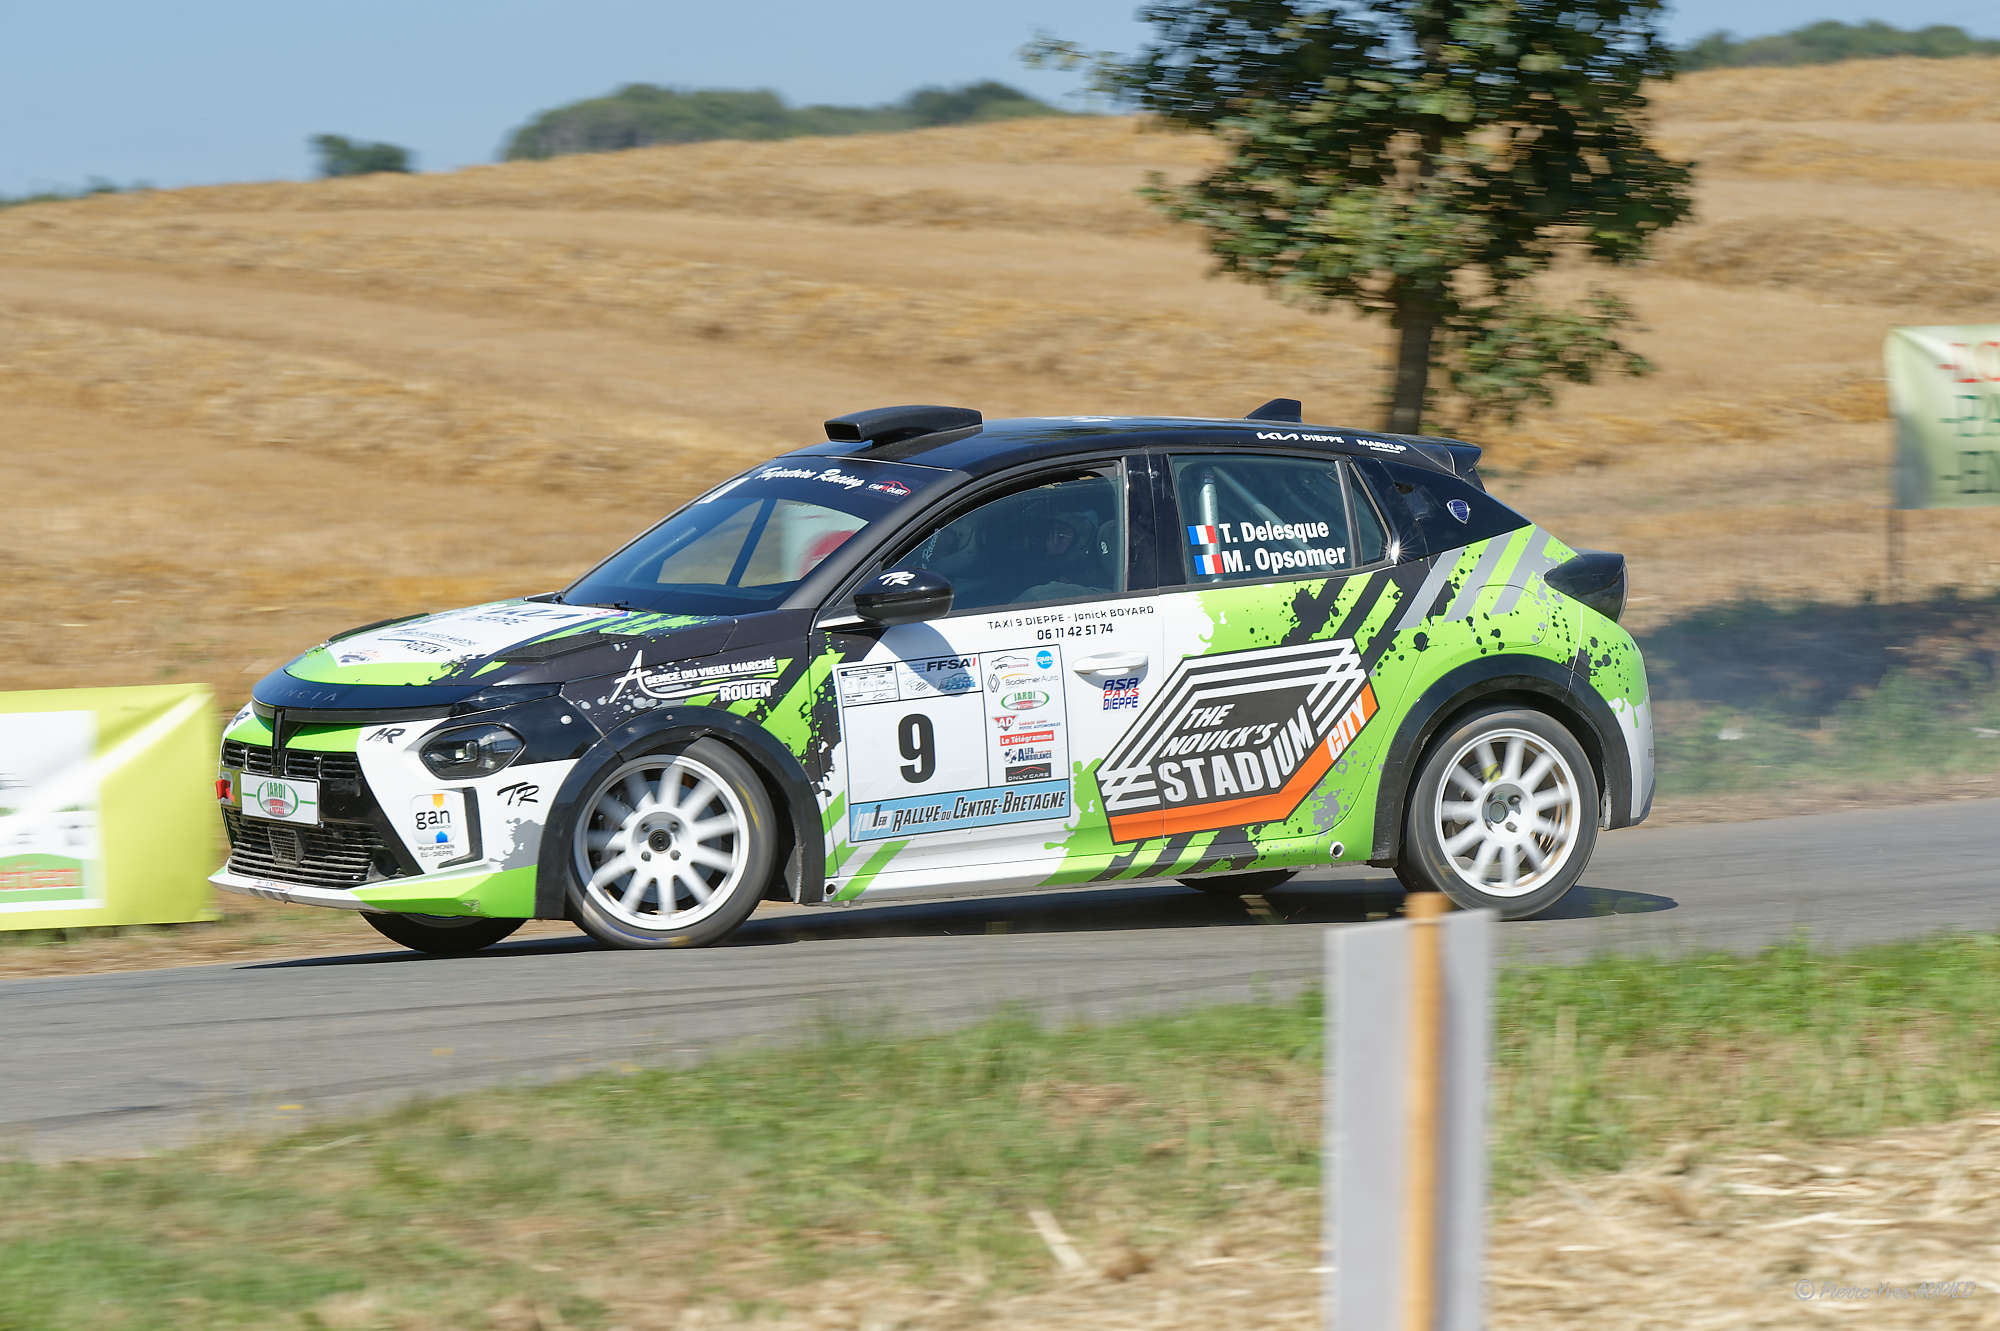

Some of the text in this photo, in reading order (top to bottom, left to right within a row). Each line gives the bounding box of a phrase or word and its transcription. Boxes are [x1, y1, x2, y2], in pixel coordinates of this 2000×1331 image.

[1301, 434, 1345, 443] DIEPPE
[813, 469, 866, 490] Racing
[1218, 520, 1330, 544] T. Delesque
[1222, 546, 1346, 575] M. Opsomer
[987, 620, 1013, 630] TAXI
[1025, 613, 1065, 627] DIEPPE
[1074, 610, 1107, 622] Janick
[1110, 605, 1154, 618] BOYARD
[1037, 622, 1114, 641] 06 11 42 51 74
[681, 669, 698, 680] DU
[698, 664, 732, 678] VIEUX
[732, 656, 777, 673] MARCHÉ
[926, 658, 971, 672] FFSA
[719, 682, 772, 702] ROUEN
[1006, 677, 1040, 686] Bodemer
[1103, 677, 1139, 690] ASA
[1103, 688, 1139, 699] PAYS
[1103, 696, 1139, 711] DIEPPE
[999, 717, 1013, 728] AD
[1182, 703, 1236, 730] THE
[1001, 732, 1053, 744] Le Télégramme
[1326, 697, 1368, 761] CITY
[898, 713, 936, 783] 9
[1158, 722, 1279, 759] NOVICK'S
[1158, 704, 1315, 803] STADIUM
[1008, 774, 1028, 782] ONLY
[497, 781, 539, 807] TR
[415, 809, 451, 830] gan
[891, 805, 941, 832] RALLYE
[953, 790, 1067, 819] CENTRE-BRETAGNE
